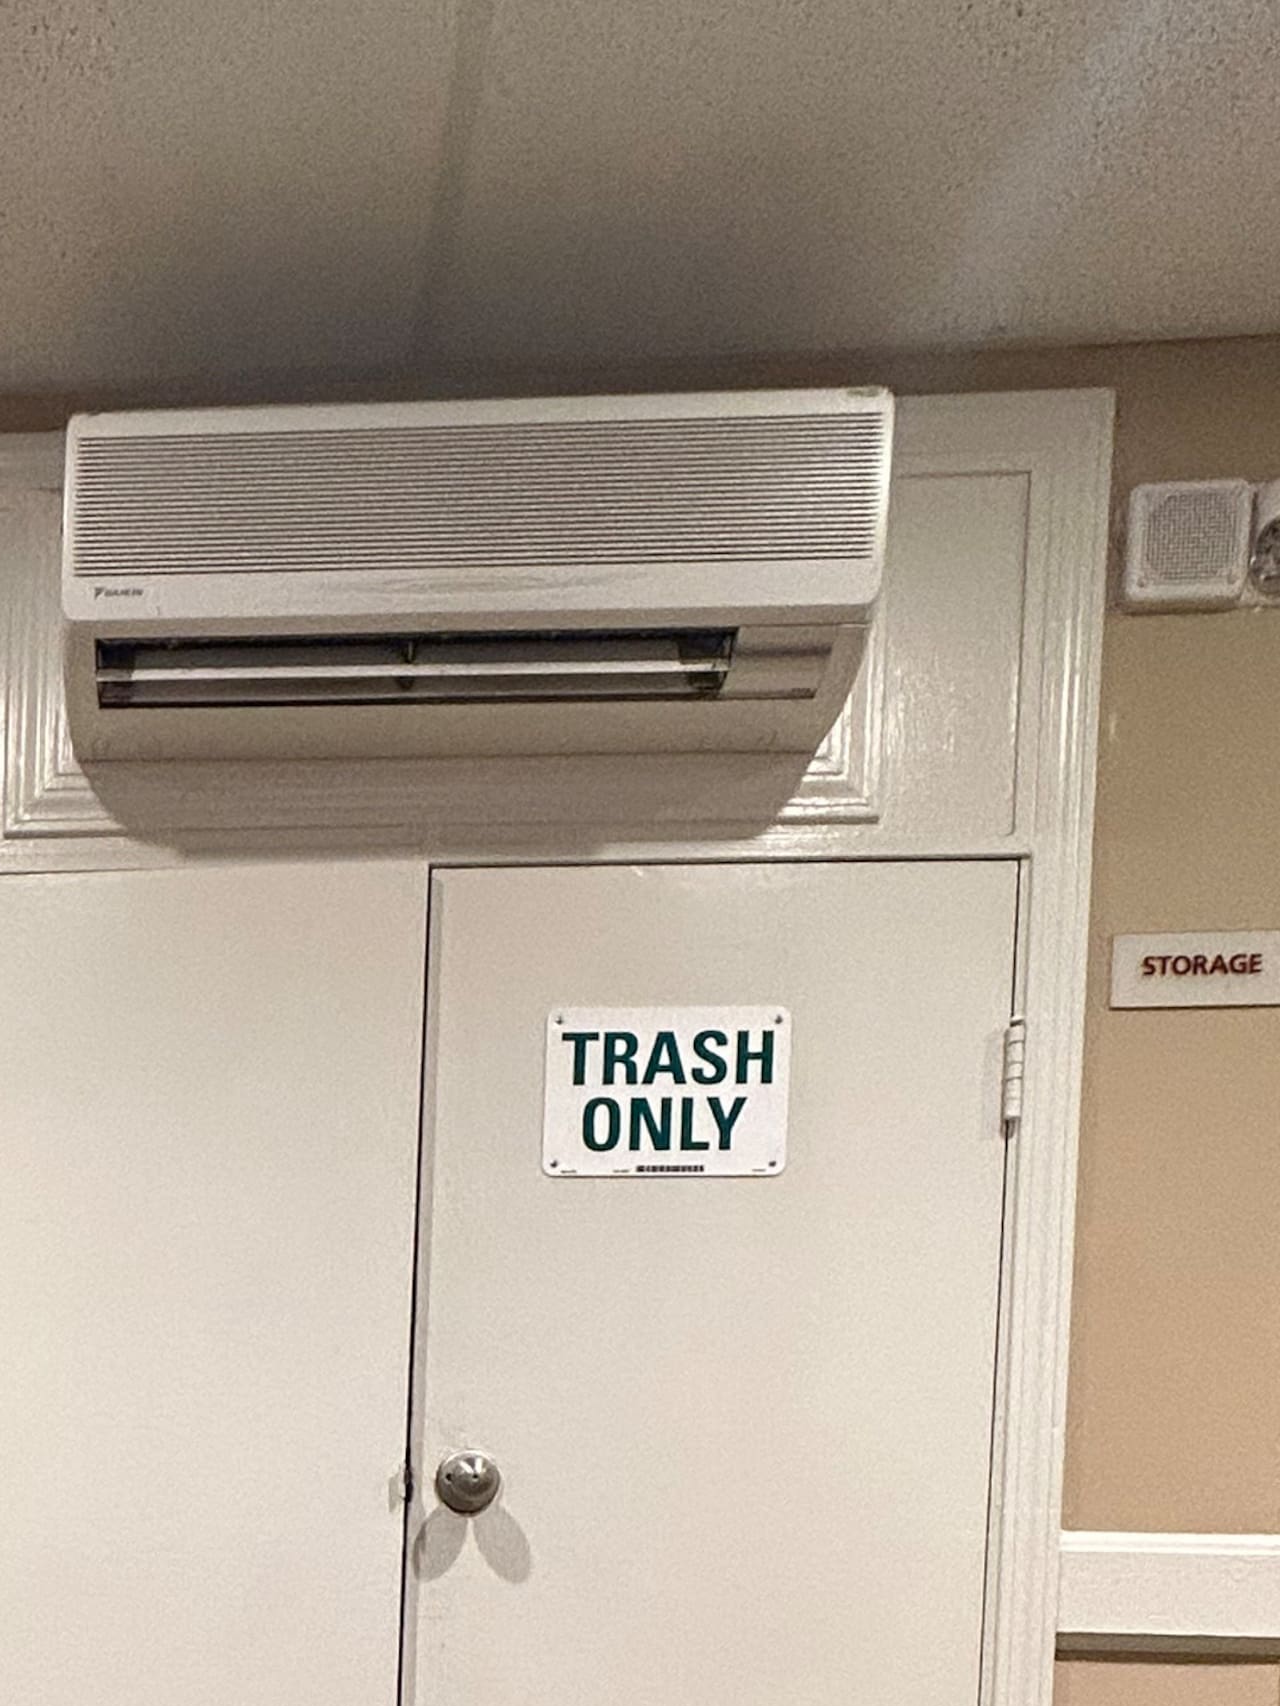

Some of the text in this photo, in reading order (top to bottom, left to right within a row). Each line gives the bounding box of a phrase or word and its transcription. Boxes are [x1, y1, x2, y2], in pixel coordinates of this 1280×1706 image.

[1142, 953, 1263, 976] STORAGE
[562, 1030, 774, 1085] TRASH
[582, 1096, 748, 1152] ONLY
